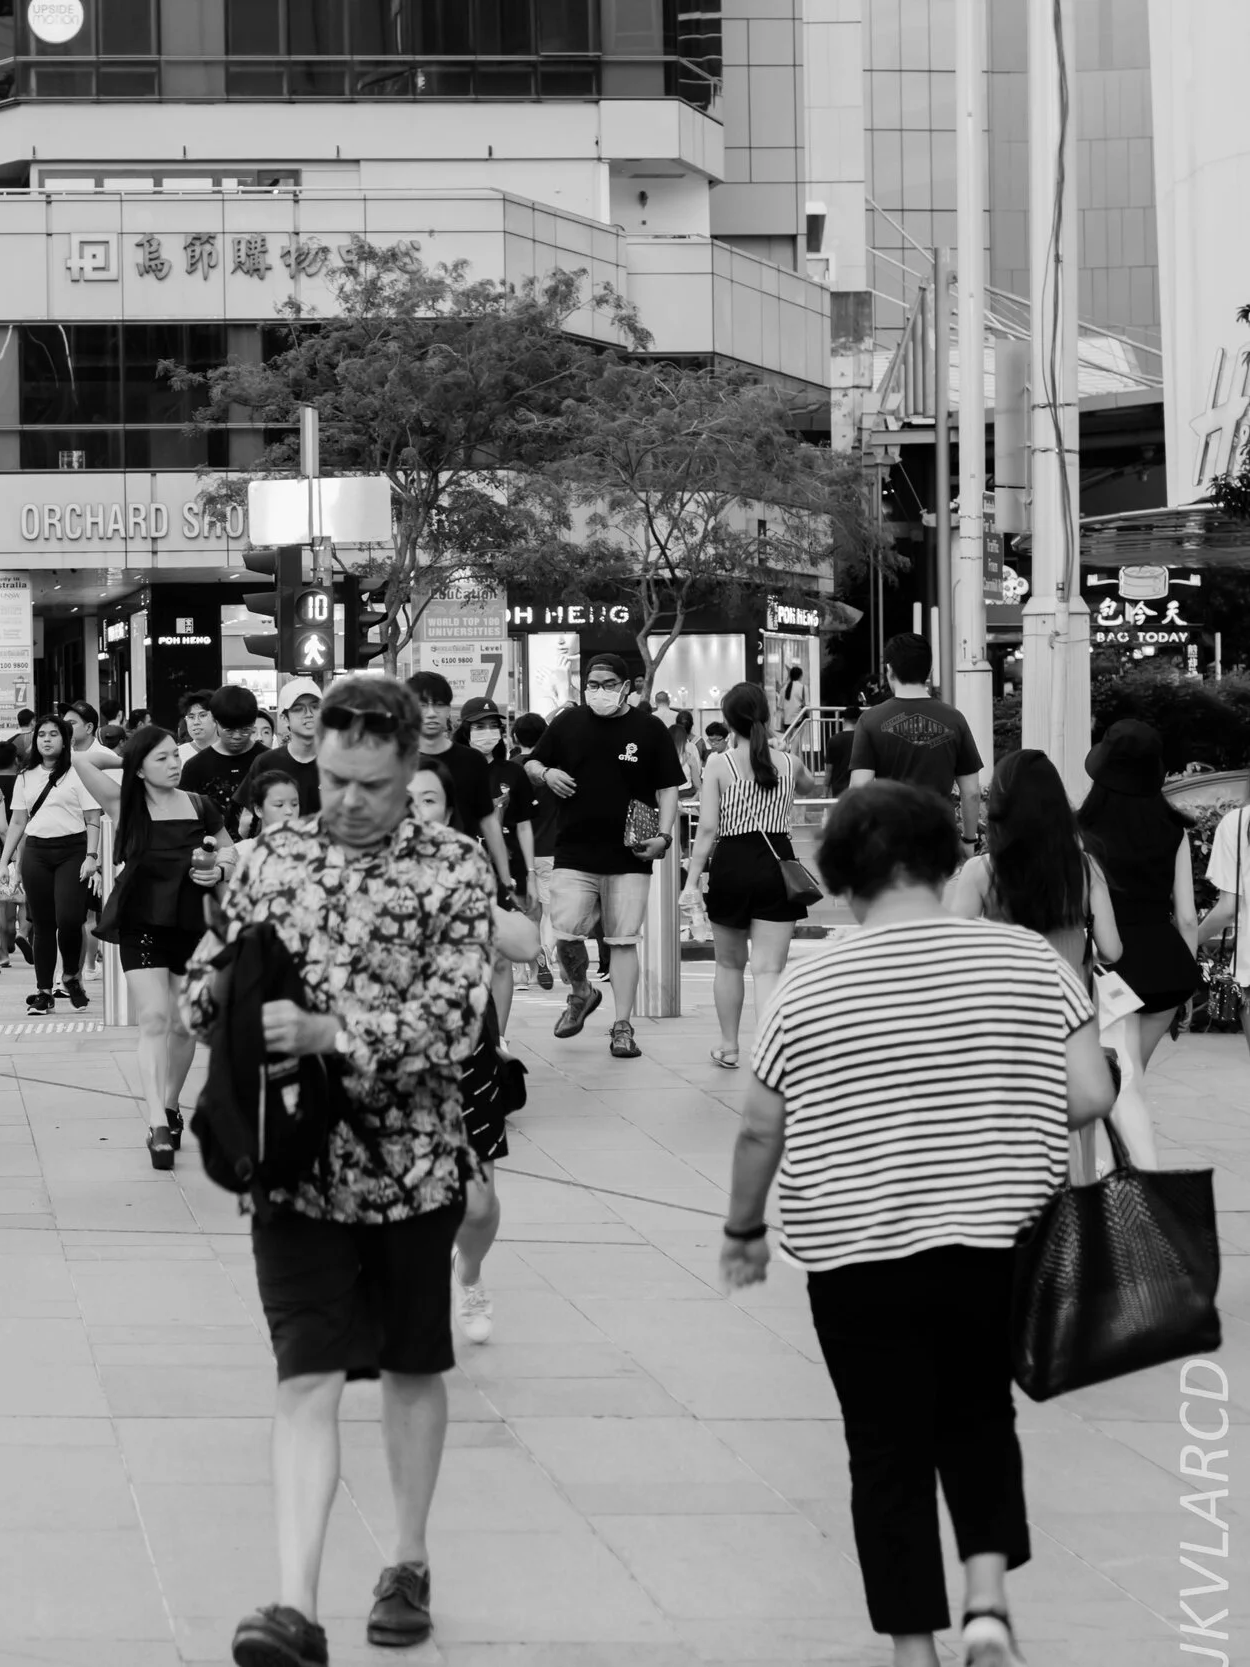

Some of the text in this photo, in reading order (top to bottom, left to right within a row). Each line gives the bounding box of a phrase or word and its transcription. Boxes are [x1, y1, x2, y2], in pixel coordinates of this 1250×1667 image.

[33, 4, 75, 14] UPSIDE
[20, 502, 246, 541] ORCHARD SHO
[307, 594, 328, 620] 10
[427, 617, 501, 627] WORLD TOP 100
[427, 627, 502, 637] UNIVERSITIES
[1137, 631, 1189, 643] TODAY
[158, 636, 212, 645] POH HENG
[480, 644, 503, 652] Level
[480, 653, 503, 698] 7
